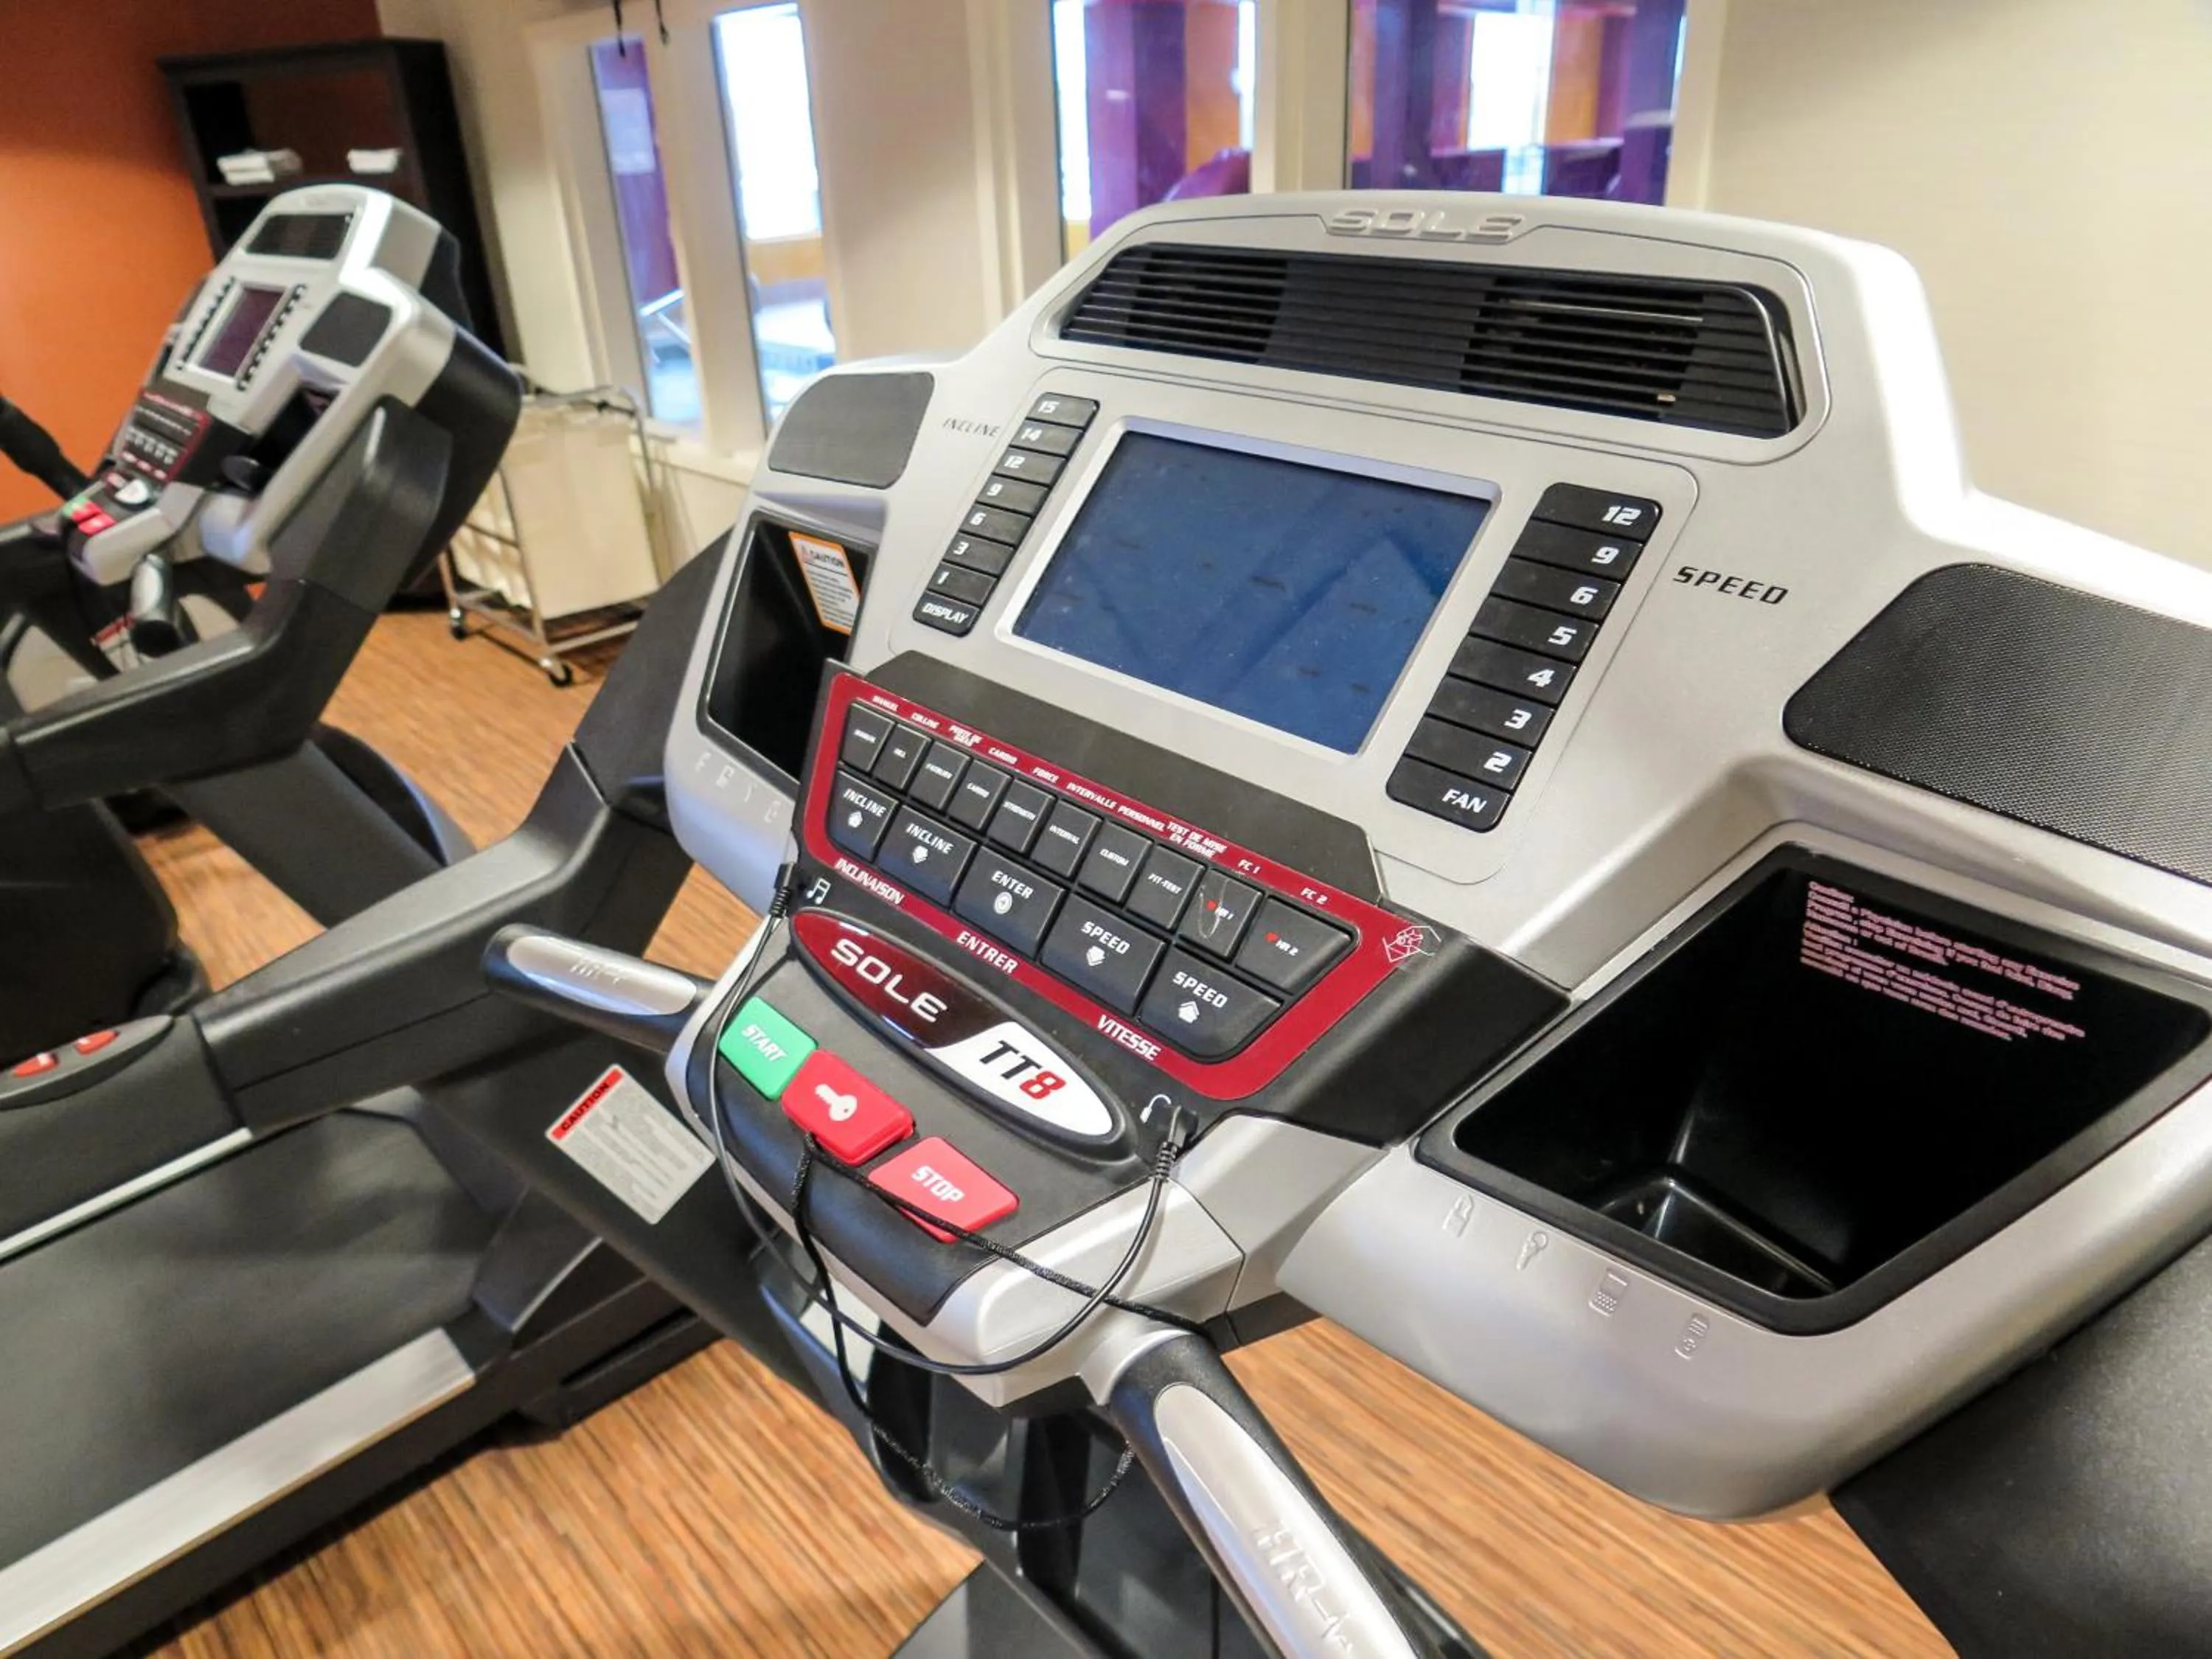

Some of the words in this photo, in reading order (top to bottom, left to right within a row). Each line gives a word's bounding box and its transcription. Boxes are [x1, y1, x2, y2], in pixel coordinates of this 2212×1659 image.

[1327, 209, 1525, 241] SOLE
[1038, 400, 1059, 414] 15
[943, 417, 1001, 438] INCLINE
[1020, 427, 1043, 440] 14
[1004, 455, 1025, 468] 12
[987, 483, 1002, 496] 9
[970, 512, 987, 526] 6
[1603, 505, 1642, 526] 12
[953, 541, 969, 555] 3
[1591, 546, 1619, 566] 9
[938, 571, 950, 584] 1
[1673, 565, 1789, 605] SPEED
[1570, 585, 1599, 606] 6
[922, 602, 969, 625] DISPLAY
[1548, 625, 1577, 646] 5
[1528, 669, 1556, 688] 4
[1504, 709, 1532, 730] 3
[1484, 751, 1512, 772] 2
[1032, 767, 1060, 783] FORCE
[844, 788, 887, 817] INCLINE
[1066, 782, 1117, 810] INTERVALLE
[1442, 789, 1486, 813] FAN
[1117, 805, 1166, 832] PERSONNEL
[905, 823, 954, 855] INCLINE
[1237, 859, 1253, 872] FC
[834, 858, 905, 904] INCLINAISON
[991, 871, 1034, 899] ENTER
[1301, 888, 1317, 900] FC
[1316, 895, 1329, 905] 2
[1080, 921, 1130, 955] SPEED
[957, 931, 1018, 973] ENTRER
[831, 939, 947, 1023] SOLE
[1172, 971, 1228, 1009] SPEED
[742, 1024, 789, 1062] START
[1097, 1015, 1163, 1061] VITESSE
[979, 1040, 1066, 1100] TT8
[560, 1082, 610, 1132] CAUTION
[910, 1166, 964, 1202] STOP
